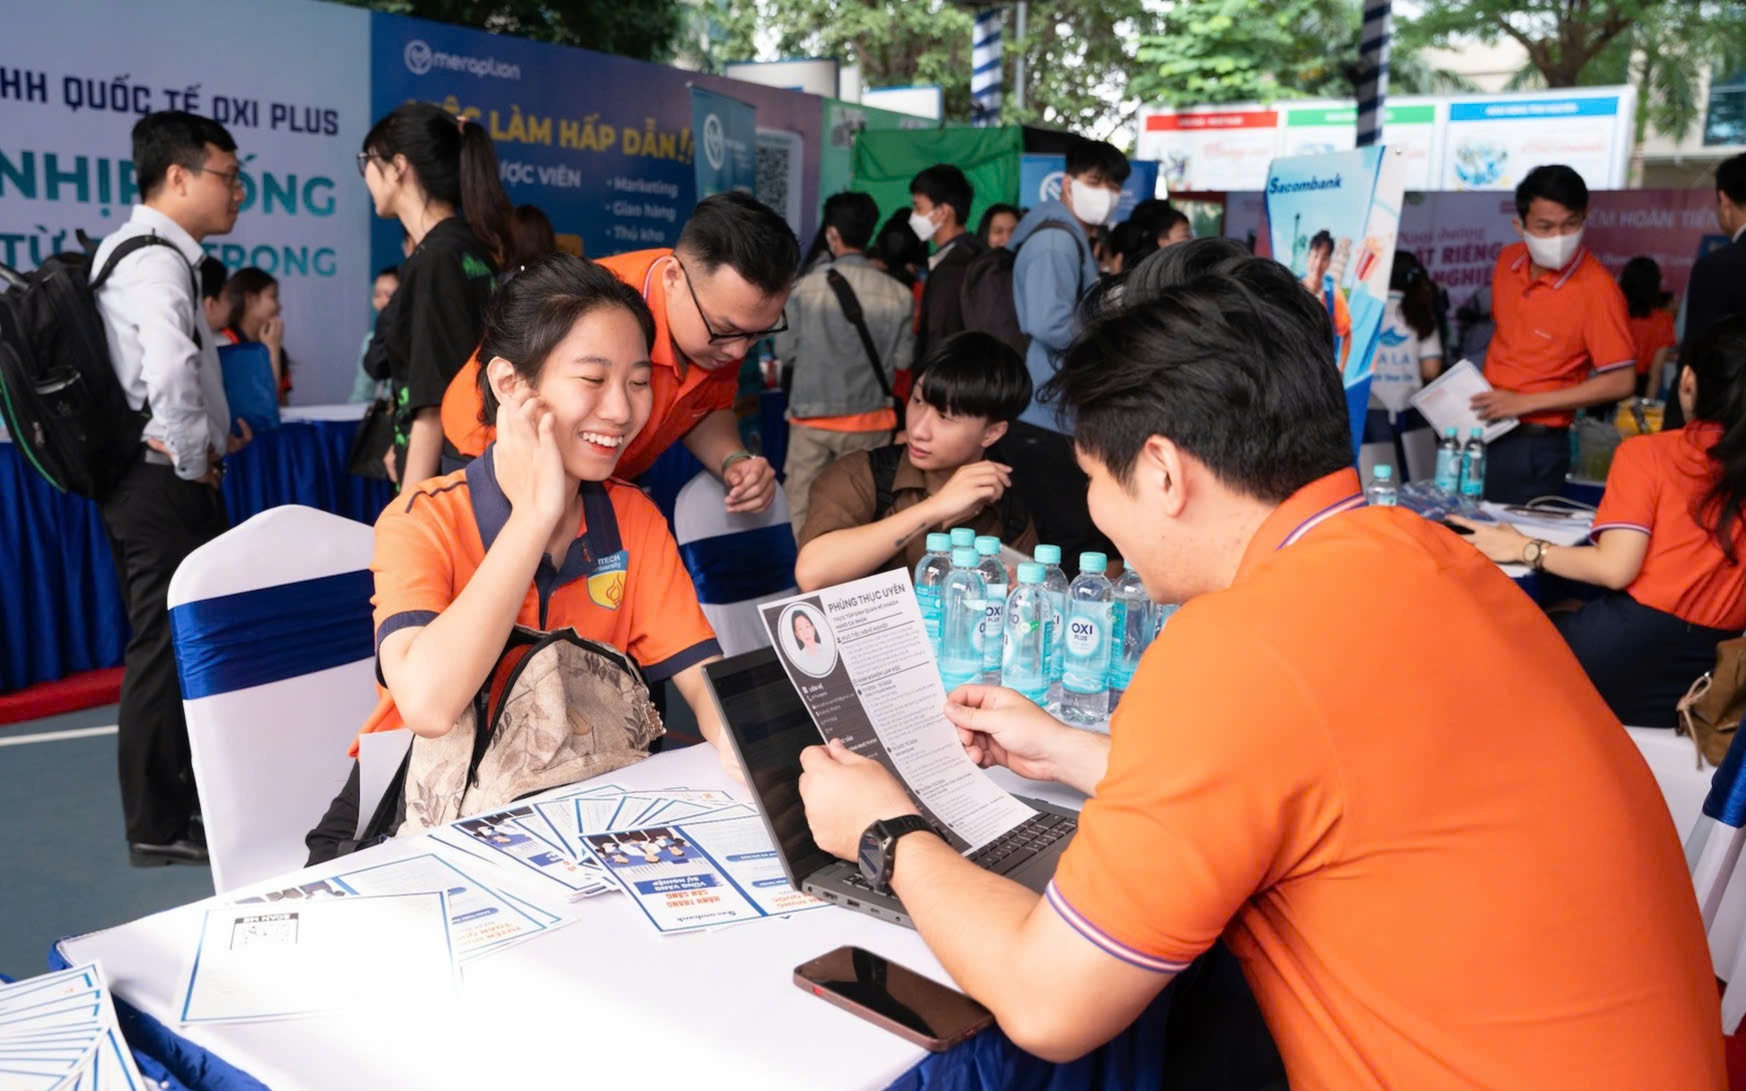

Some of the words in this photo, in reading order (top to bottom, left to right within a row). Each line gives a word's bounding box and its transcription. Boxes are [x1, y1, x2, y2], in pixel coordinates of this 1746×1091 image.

[63, 73, 151, 115] QUỐC
[163, 82, 201, 111] TẾ
[213, 96, 259, 129] OXI
[270, 103, 340, 138] PLUS
[490, 104, 553, 146] LÀM
[560, 114, 615, 151] HẤP
[537, 163, 582, 188] VIÊN
[1269, 173, 1342, 195] Sacombank
[614, 177, 679, 198] Marketing
[1071, 622, 1093, 635] OXI
